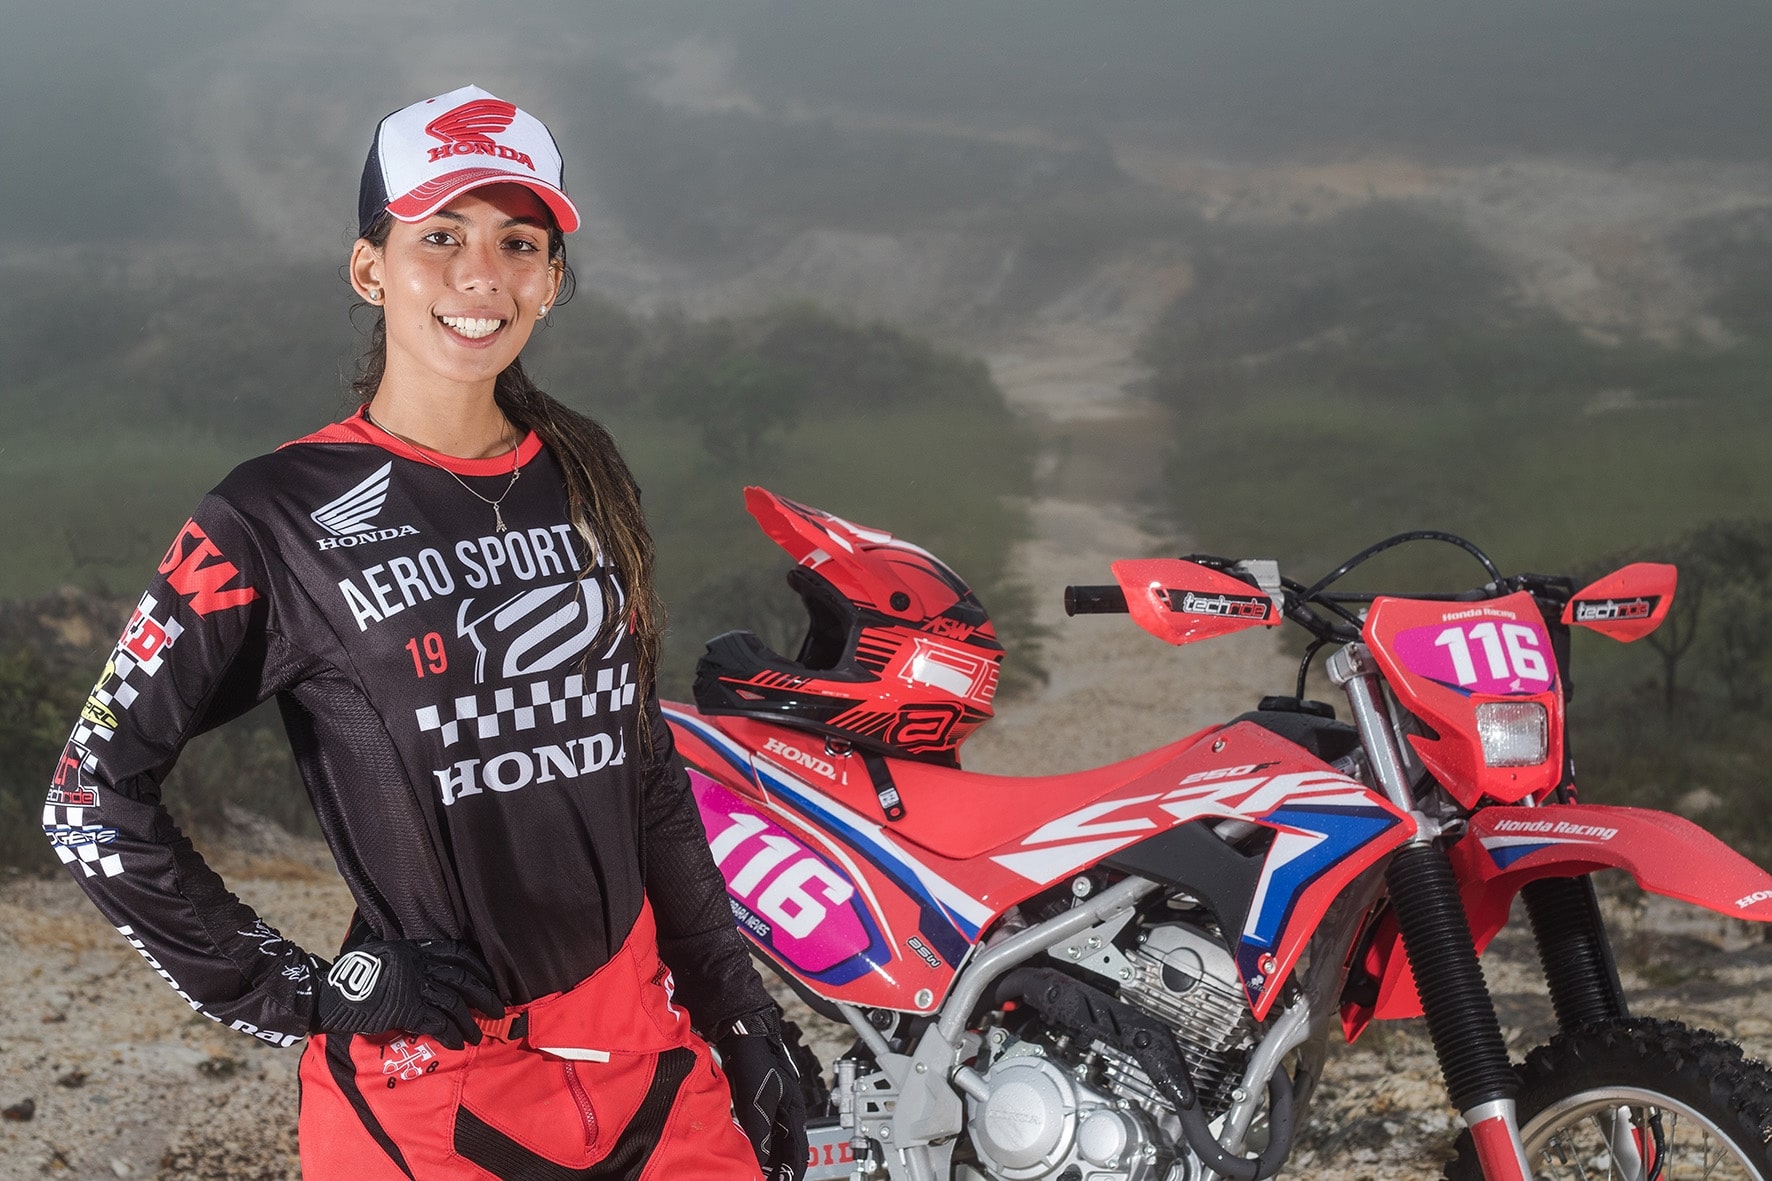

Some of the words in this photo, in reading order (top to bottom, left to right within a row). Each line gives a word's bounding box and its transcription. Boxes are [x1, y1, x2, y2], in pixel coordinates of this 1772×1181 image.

[427, 141, 536, 172] HONDA
[316, 524, 421, 551] HONDA
[337, 548, 456, 633] AERO
[454, 523, 581, 590] SPORT
[1442, 609, 1482, 621] Honda
[1483, 607, 1516, 620] Racing
[404, 631, 449, 679] 19
[1434, 622, 1549, 686] 116
[1494, 819, 1554, 833] Honda
[1552, 821, 1619, 841] Racing
[709, 812, 855, 940] 116
